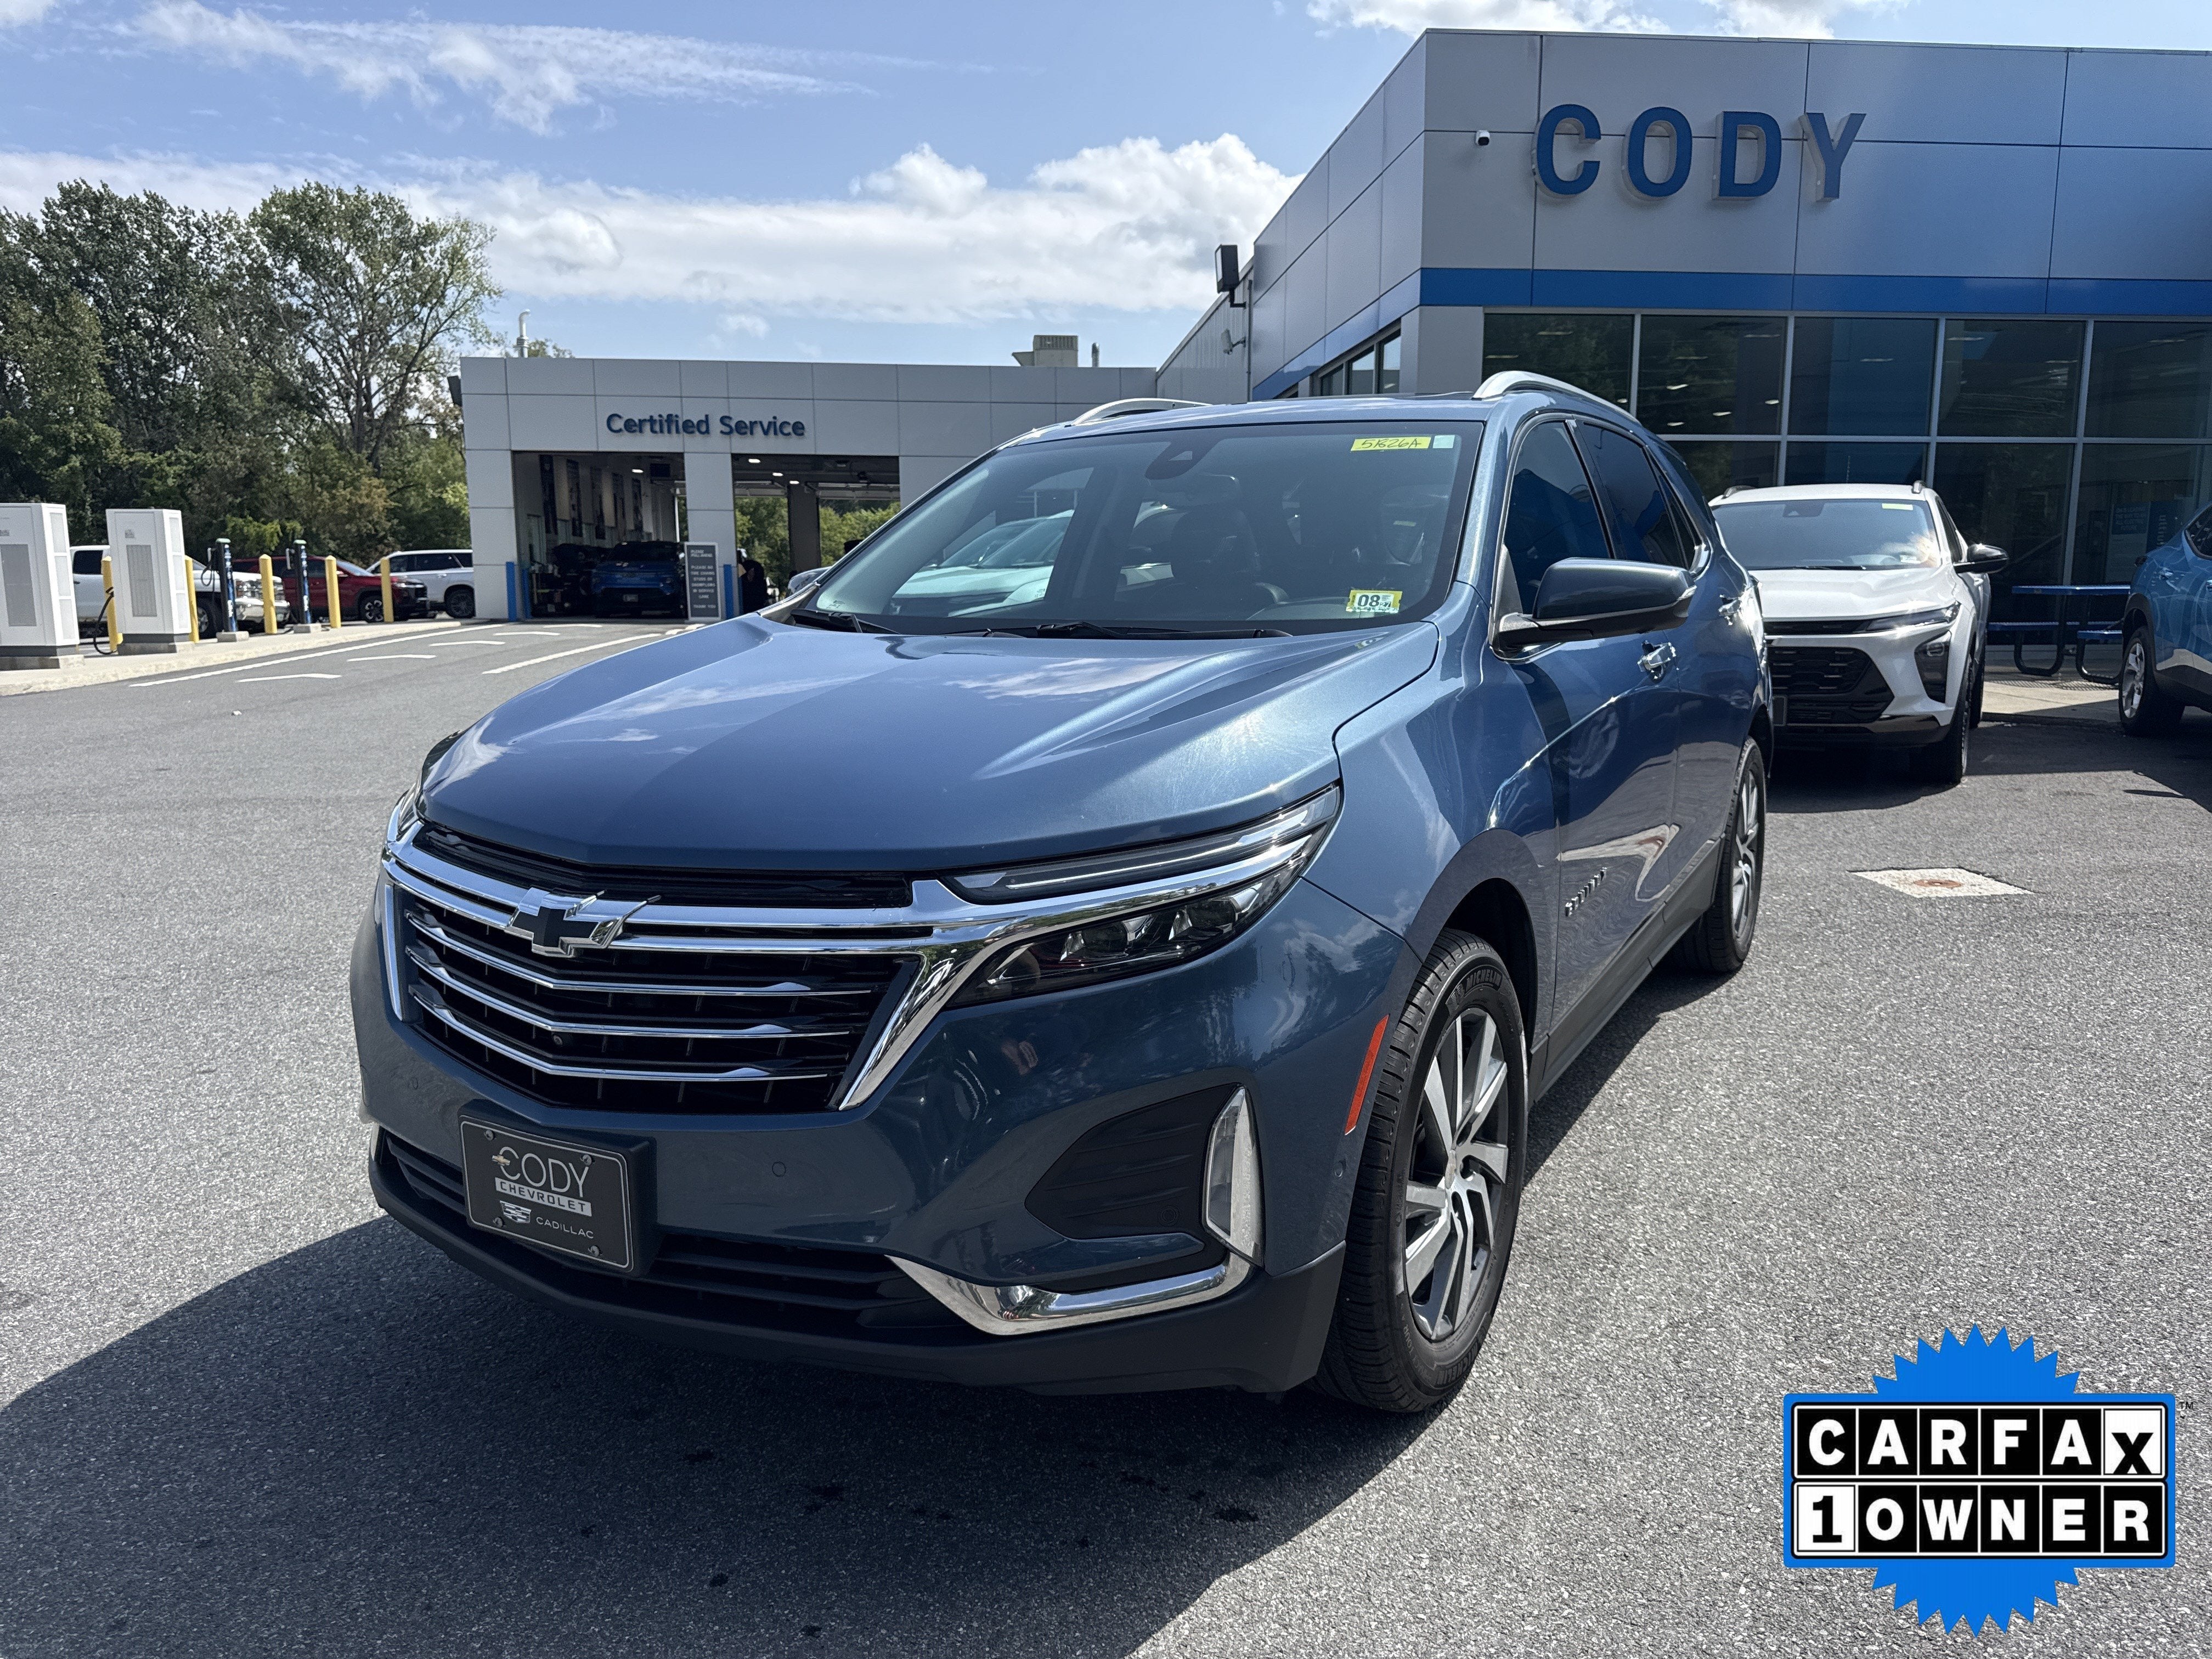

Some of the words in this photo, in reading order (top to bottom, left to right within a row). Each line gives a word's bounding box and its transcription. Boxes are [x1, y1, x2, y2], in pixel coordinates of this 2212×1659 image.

[1533, 103, 1866, 201] CODY
[606, 413, 710, 435] Certified
[719, 416, 805, 437] Service
[1358, 595, 1380, 607] 08
[1466, 969, 1502, 991] MICHELIN
[498, 1146, 589, 1198] CODY
[500, 1181, 586, 1212] CHEVROLET
[536, 1216, 594, 1239] CADILLAC
